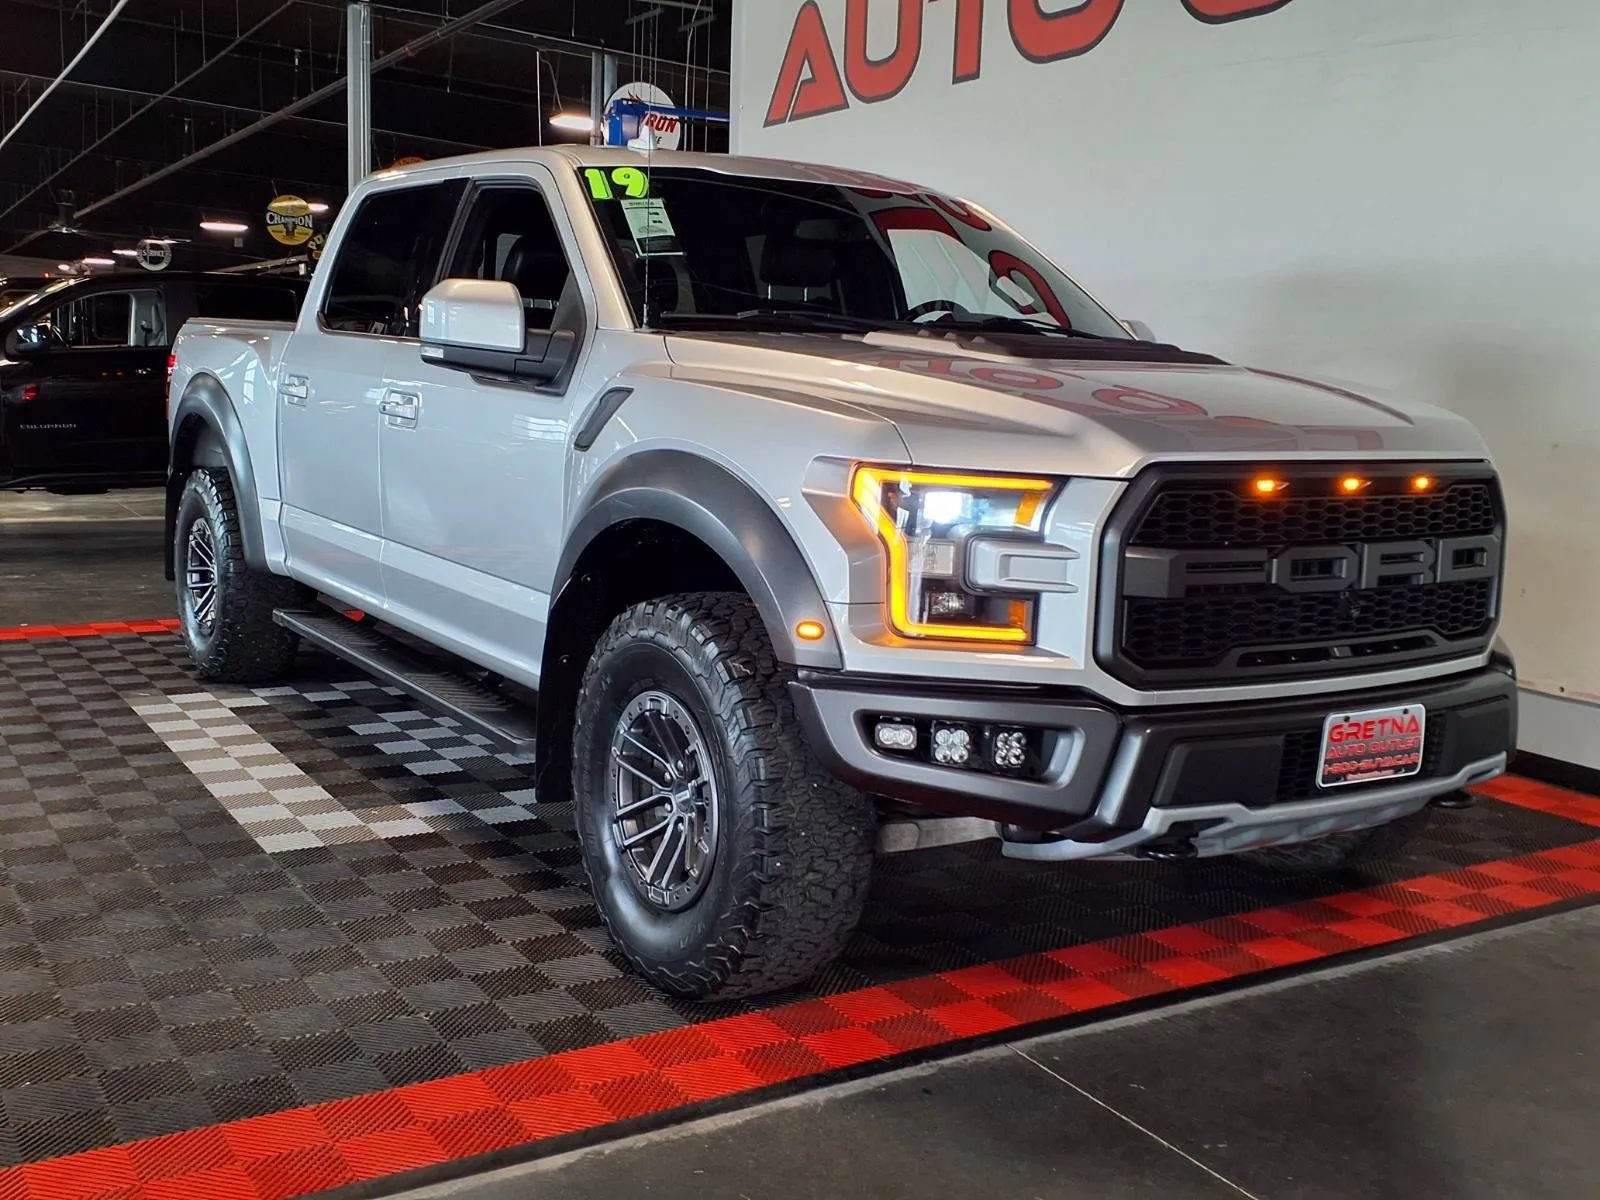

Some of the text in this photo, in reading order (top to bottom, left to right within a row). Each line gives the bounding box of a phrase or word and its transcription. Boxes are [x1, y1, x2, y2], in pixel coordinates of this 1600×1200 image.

[585, 167, 649, 199] 19
[1164, 535, 1501, 599] FORD
[1330, 715, 1419, 742] GRETNA
[1327, 736, 1421, 759] AUTO OUTLET
